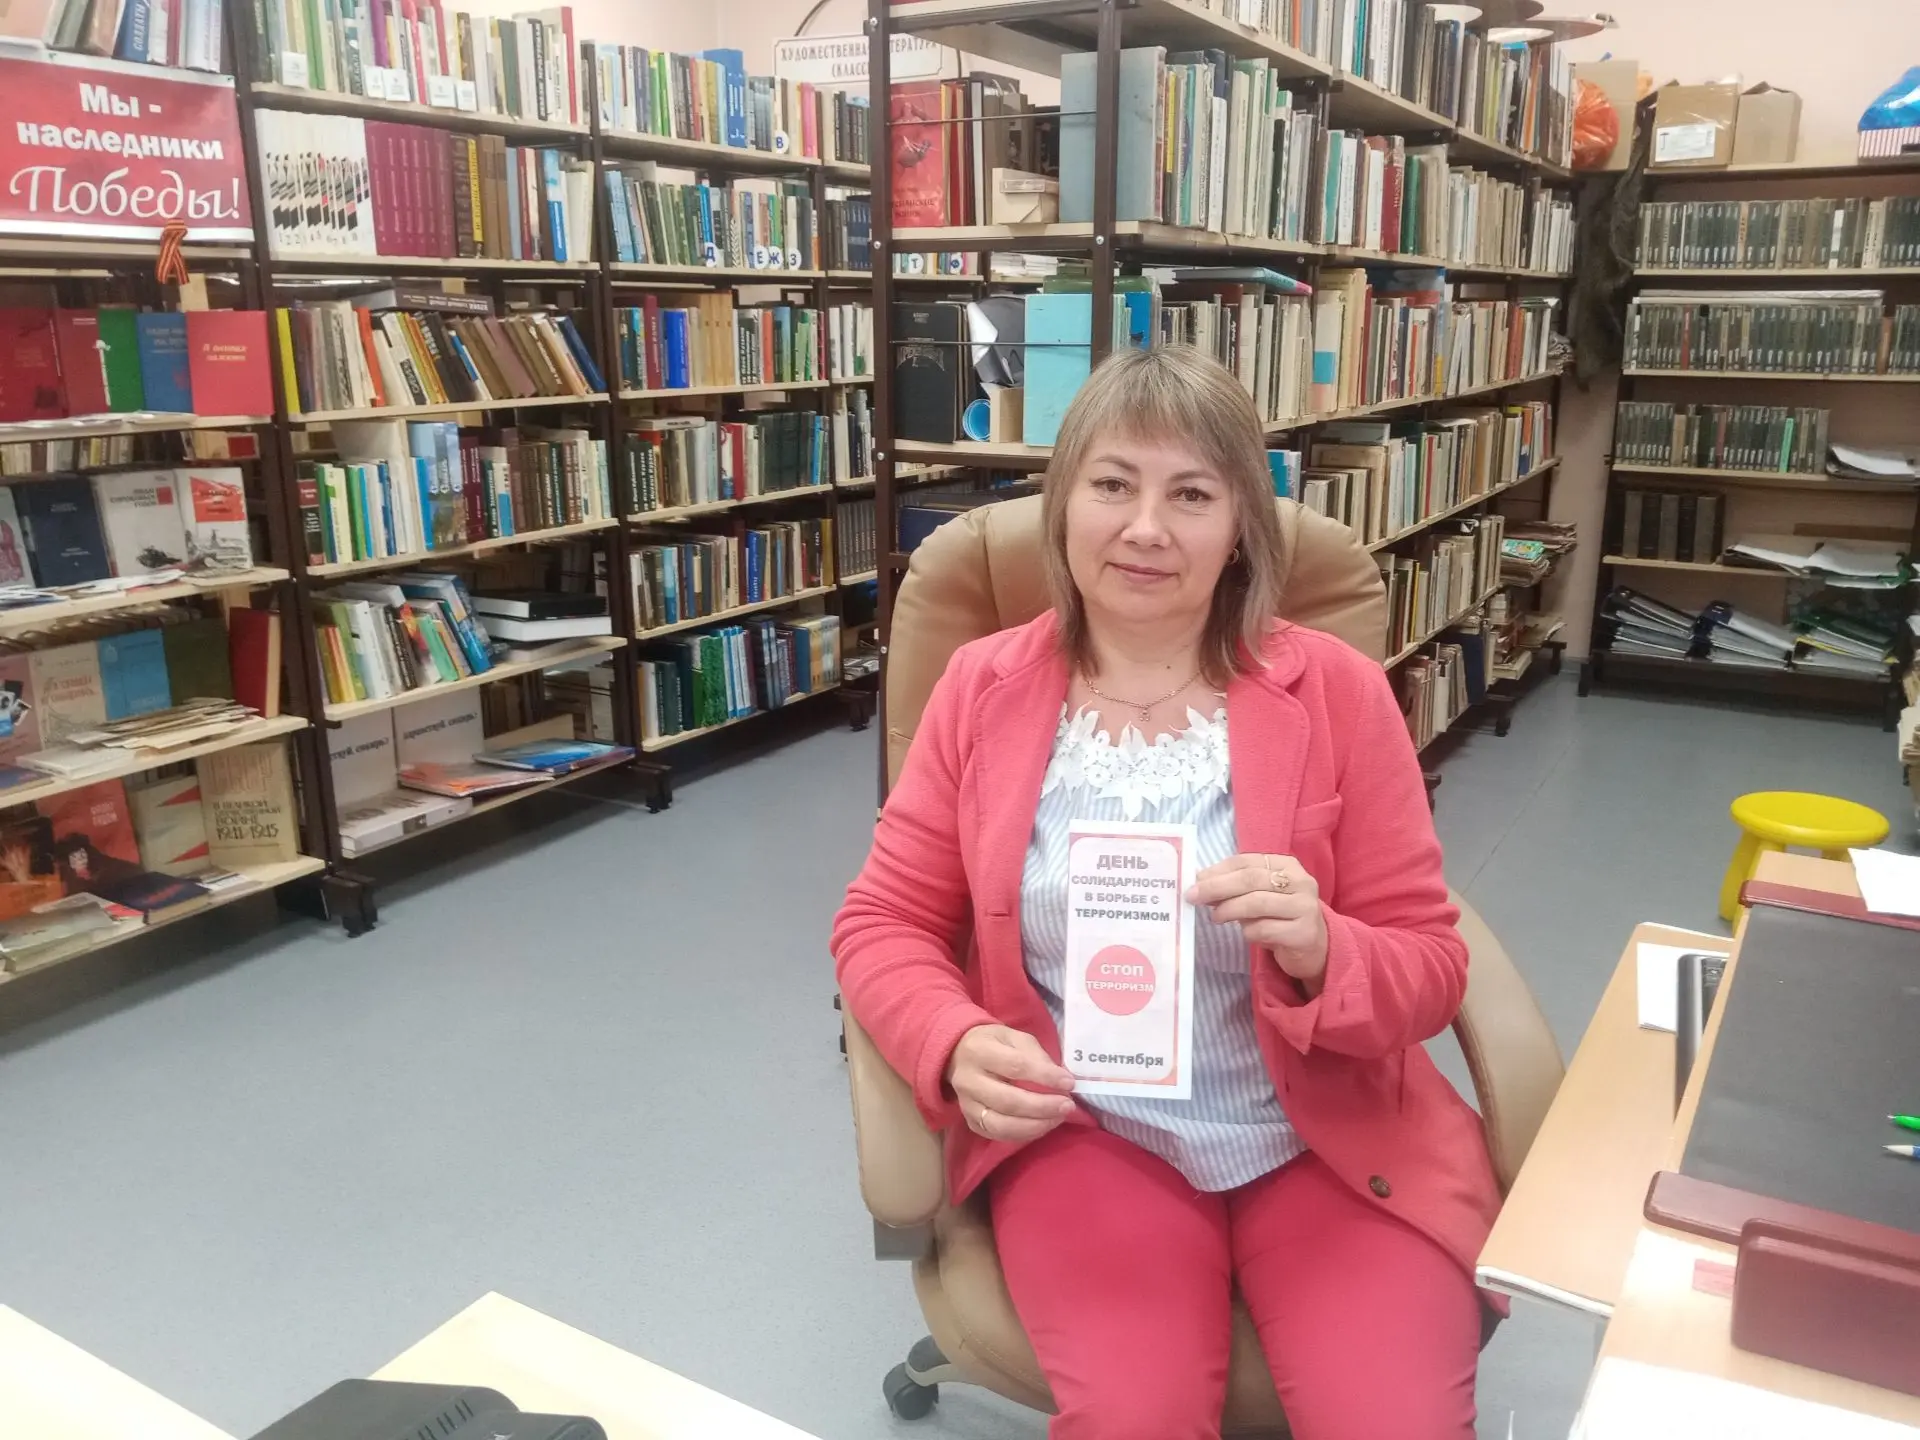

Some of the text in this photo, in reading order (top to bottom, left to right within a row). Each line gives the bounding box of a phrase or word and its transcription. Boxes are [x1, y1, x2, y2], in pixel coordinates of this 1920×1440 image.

[781, 42, 869, 61] ХУДОЖЕСТВЕННА
[79, 82, 162, 118] Мы -
[16, 121, 224, 160] наследники
[776, 136, 784, 149] В
[9, 165, 240, 220] Победы!
[704, 246, 716, 262] Д
[757, 251, 763, 264] Е
[768, 251, 780, 265] Ж
[911, 258, 918, 269] Т
[1097, 854, 1149, 870] ДЕНЬ
[1071, 875, 1176, 889] СОЛИДАРНОСТИ
[1084, 892, 1160, 904] В БОРЬБЕ С
[1075, 907, 1170, 921] ТЕРРОРИЗМОМ
[1100, 963, 1144, 977] СТОП
[1085, 980, 1154, 992] ТЕРРОРИЗМ
[1074, 1049, 1164, 1069] 3 сентября
